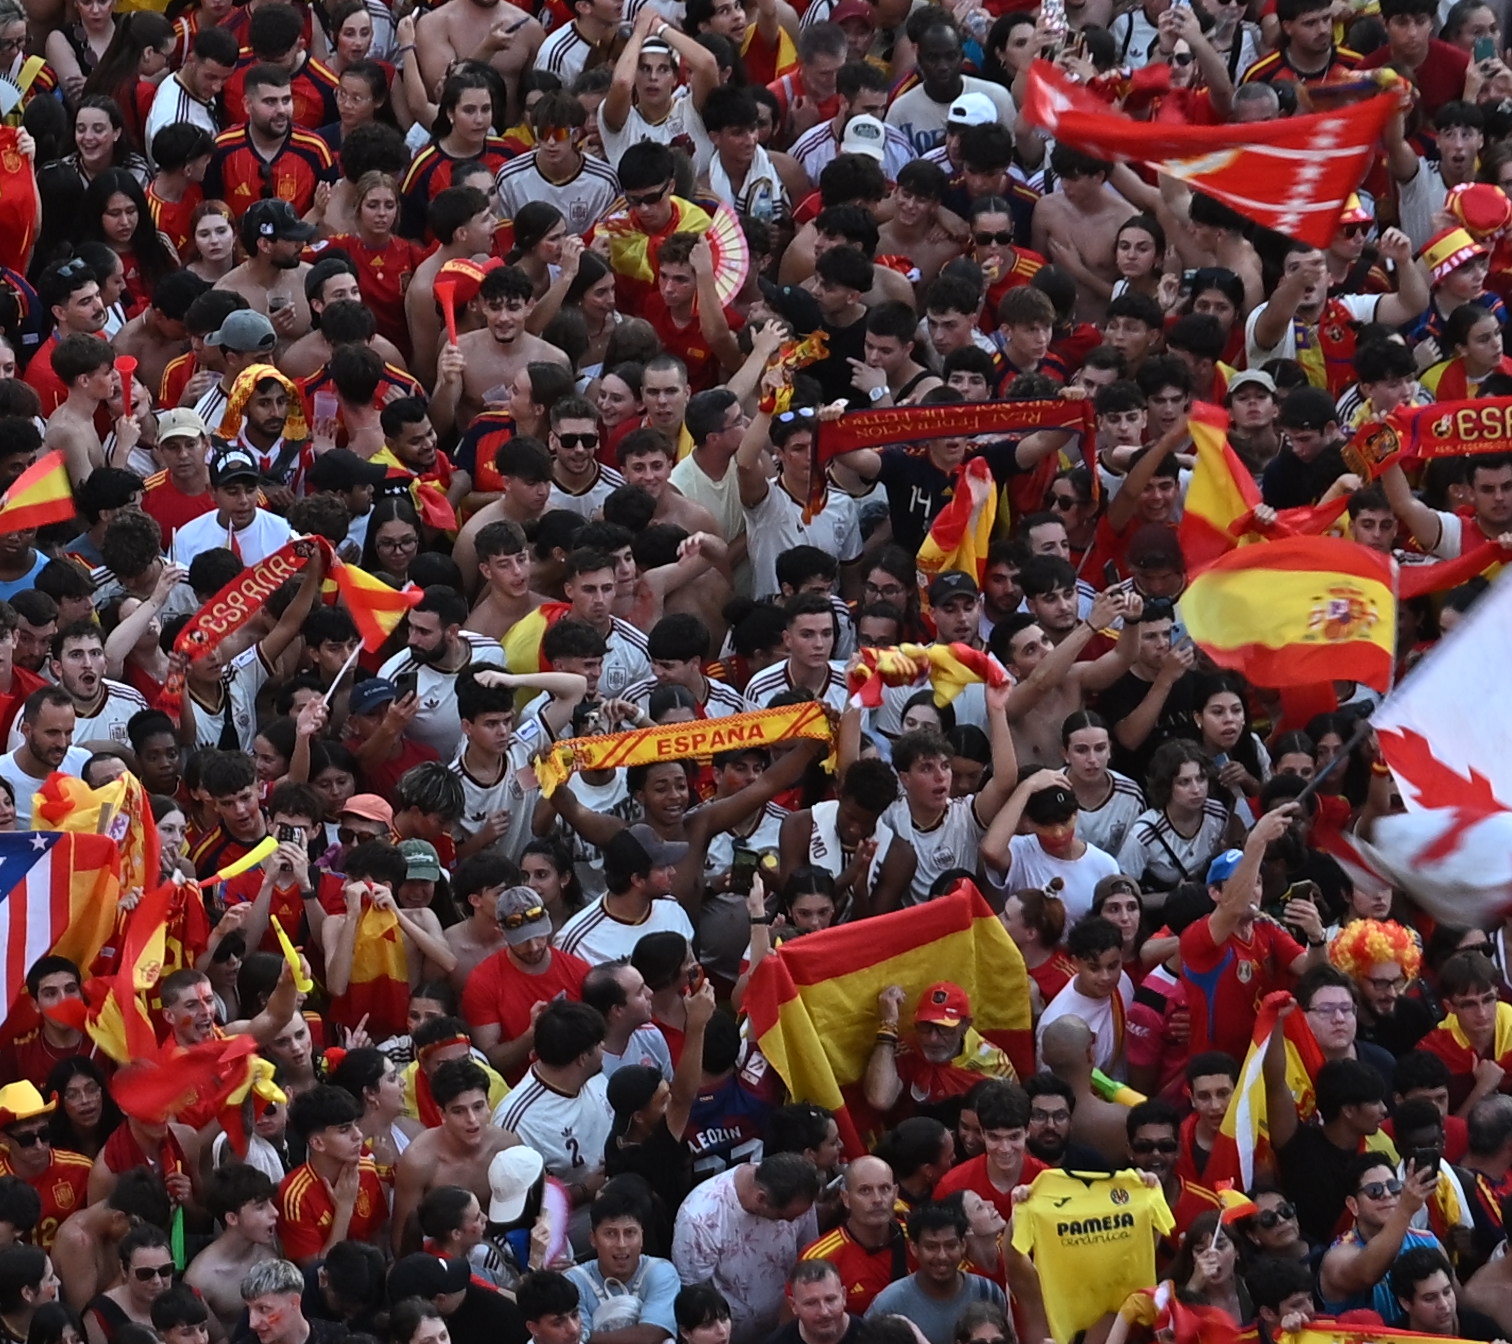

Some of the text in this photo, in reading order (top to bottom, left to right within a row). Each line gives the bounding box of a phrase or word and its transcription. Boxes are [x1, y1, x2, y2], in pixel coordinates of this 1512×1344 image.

[909, 485, 932, 518] 14
[202, 555, 295, 635] ESPAÑA
[657, 721, 765, 756] ESPAÑA
[1057, 1213, 1134, 1237] PAMESA
